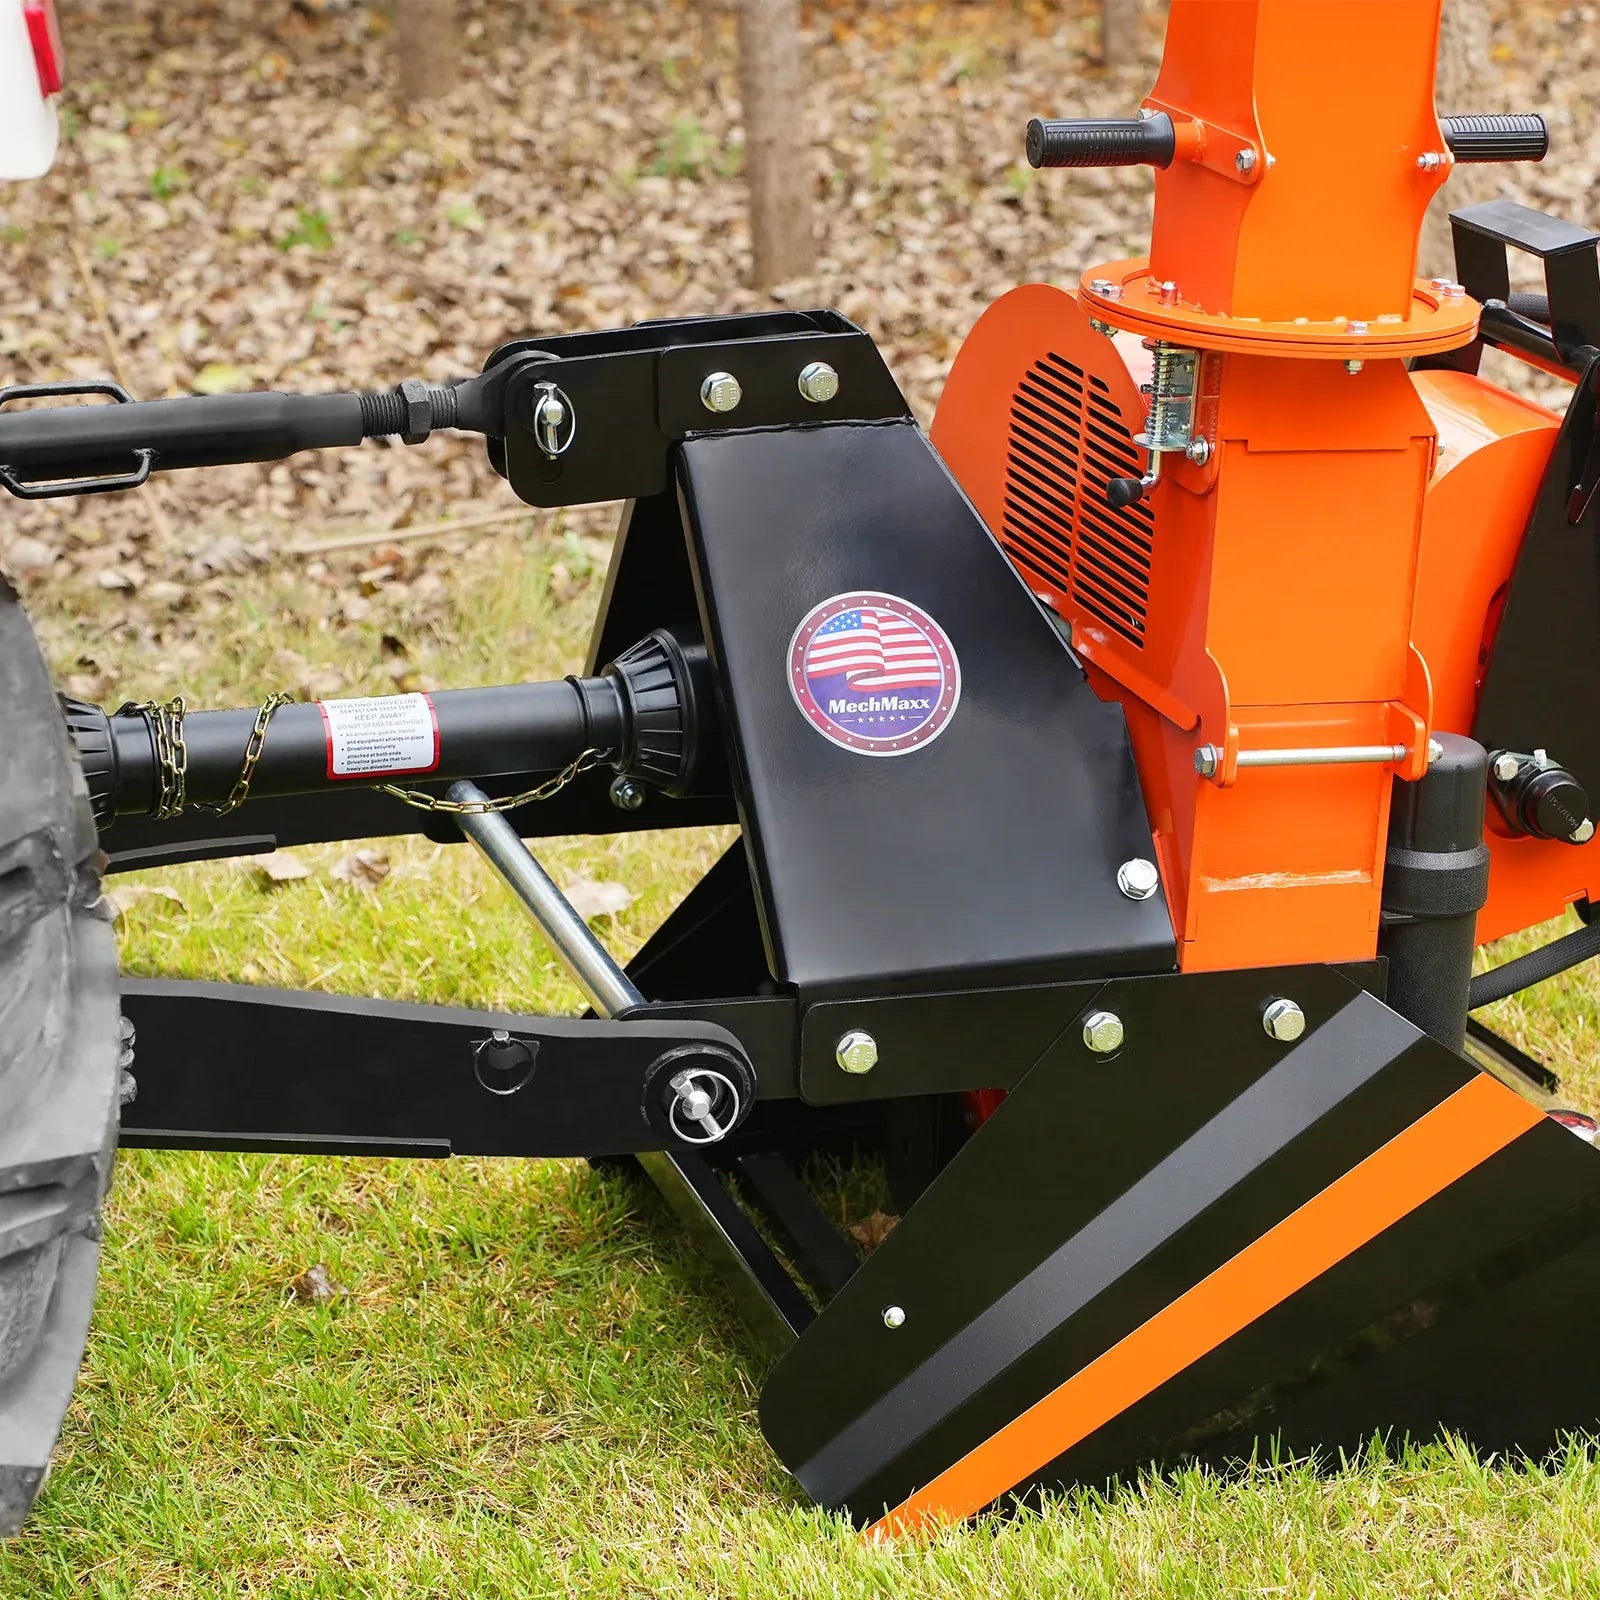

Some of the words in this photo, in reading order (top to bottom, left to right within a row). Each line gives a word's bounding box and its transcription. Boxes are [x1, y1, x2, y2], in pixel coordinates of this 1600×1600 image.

[828, 696, 930, 714] MechMaxx
[379, 712, 406, 720] AWAY!
[363, 721, 393, 729] OPERATE
[357, 737, 385, 745] equipment
[374, 743, 396, 751] securely
[370, 757, 389, 765] guards
